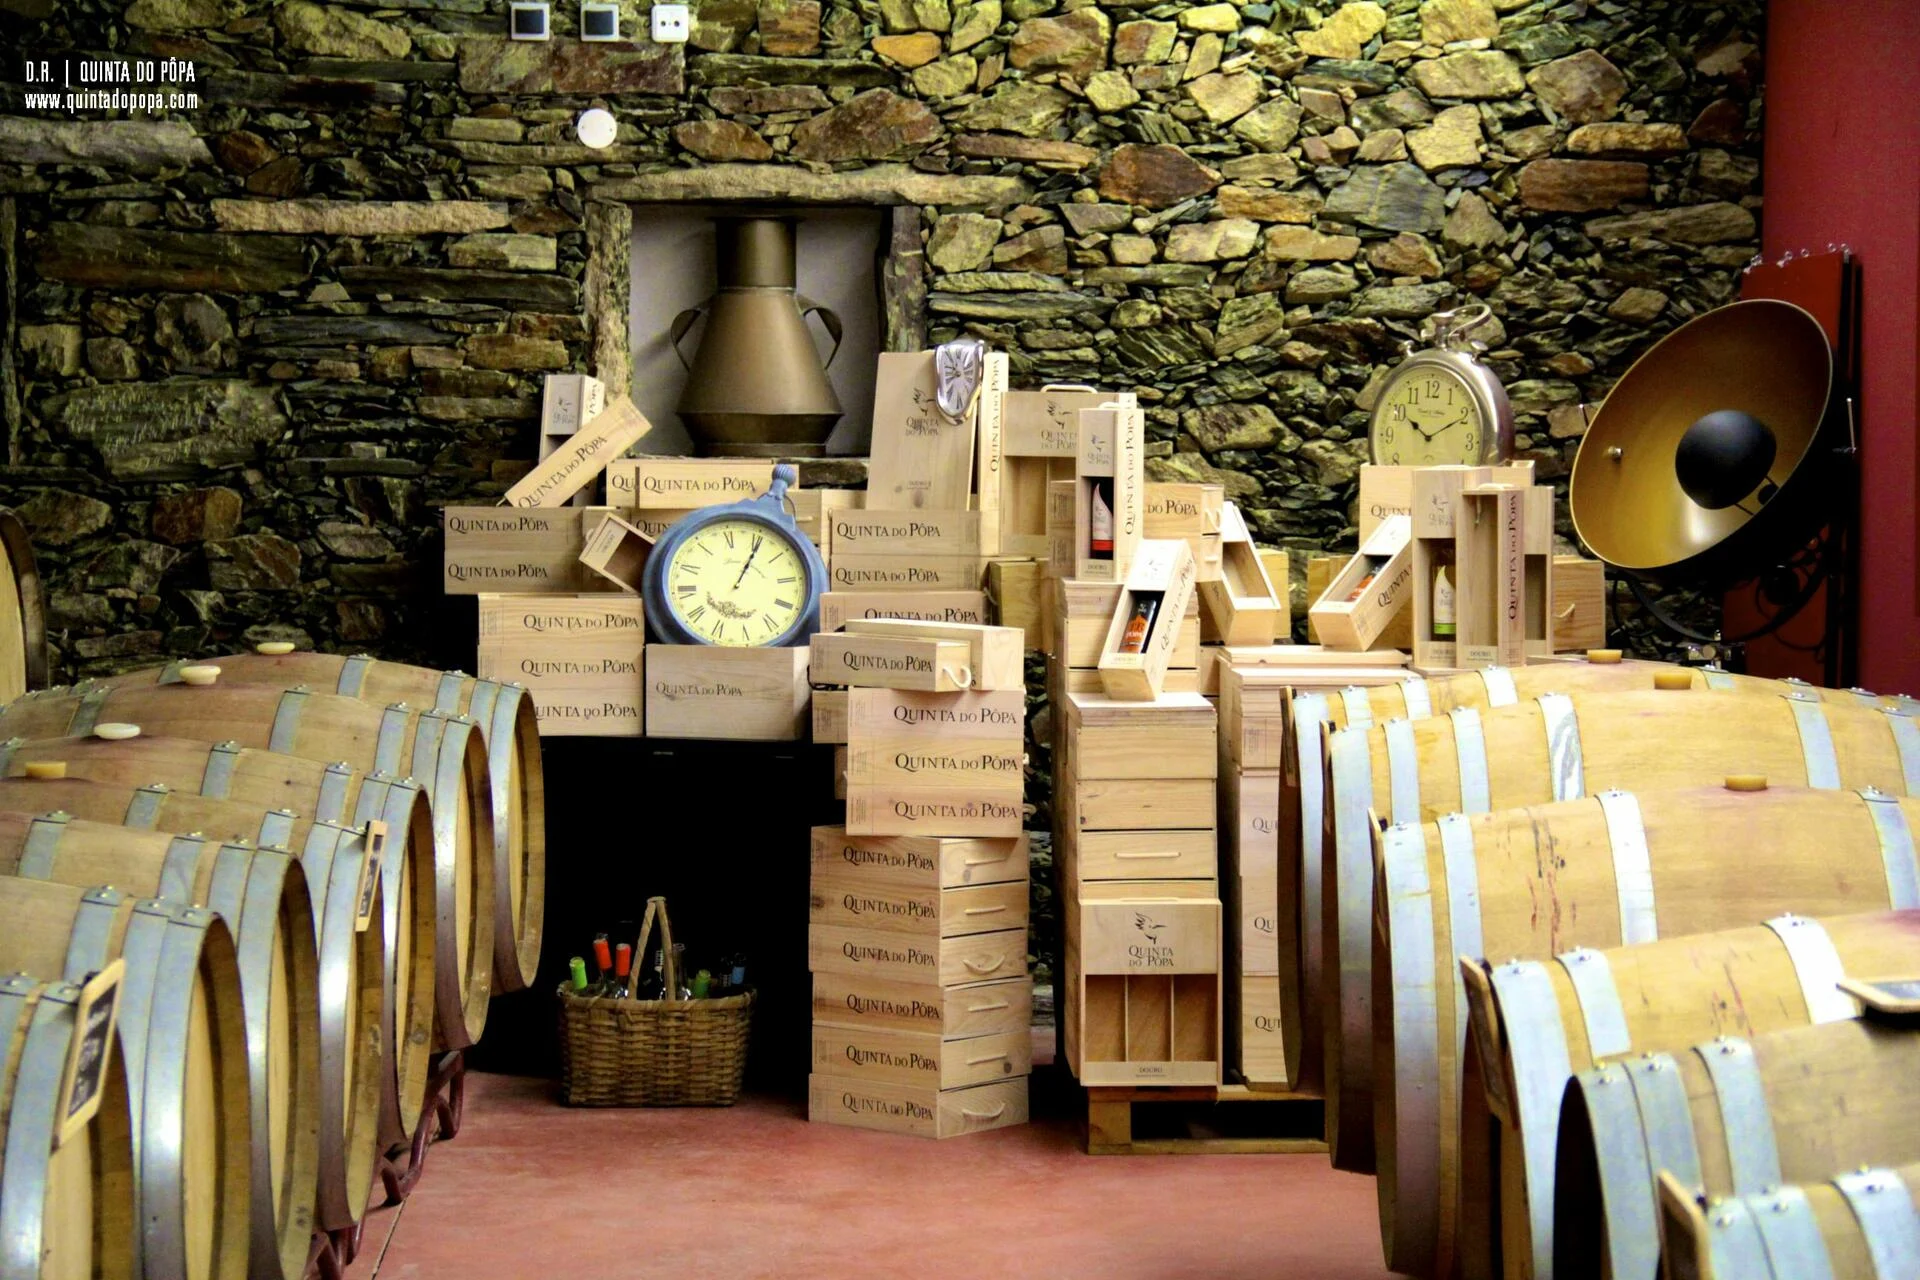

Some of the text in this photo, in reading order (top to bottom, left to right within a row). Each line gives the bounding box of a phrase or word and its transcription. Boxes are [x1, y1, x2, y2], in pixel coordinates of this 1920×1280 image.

[1408, 387, 1419, 405] 11
[1425, 380, 1440, 399] 12
[1448, 388, 1453, 405] 1
[1460, 406, 1469, 425] 2
[1385, 426, 1394, 444] 9
[1465, 433, 1474, 451] 3
[518, 436, 608, 508] QUINTA DO PÔPA
[644, 476, 757, 494] QUINTA DO PÔPA
[1126, 474, 1136, 535] QUINTA
[1147, 498, 1198, 517] DO PÔPA
[449, 516, 550, 533] QUINTA DO PÔPA
[837, 522, 889, 540] QUINTA
[892, 528, 907, 537] DO
[909, 522, 941, 537] PÔPA
[448, 563, 548, 580] QUINTA DO PÔPA
[836, 568, 940, 586] QUINTA DO PÔPA
[523, 613, 639, 630] QUINTA DO PÔPA
[944, 608, 978, 623] PÔPA
[521, 658, 638, 677] QUINTA DO PÔPA
[844, 651, 888, 671] QUINTA
[890, 659, 904, 669] DO
[906, 656, 934, 673] PÔPA
[655, 681, 743, 698] QUINTA DO PÔPA
[535, 703, 638, 720] UINTA DO PÔPA
[894, 705, 1017, 725] QUINTA DO PÔPA
[895, 753, 1018, 772] QUINTA DO PÔPA
[894, 801, 1018, 821] QUINTA DO PÔPA
[843, 846, 889, 866] QUINTA
[892, 856, 906, 867] DO
[906, 852, 935, 871] PÔPA
[843, 894, 936, 919] QUINTA DO PÔPA
[842, 942, 936, 967] QUINTA DO PÔPA
[1128, 945, 1174, 959] QUINTA
[846, 994, 894, 1014] QUINTA
[896, 1004, 910, 1015] DO
[911, 1000, 940, 1019] PÔPA
[846, 1045, 893, 1066] QUINTA
[894, 1058, 908, 1068] DO
[909, 1052, 938, 1072] PÔPA
[842, 1092, 934, 1121] QUINTA DO PÔPA
